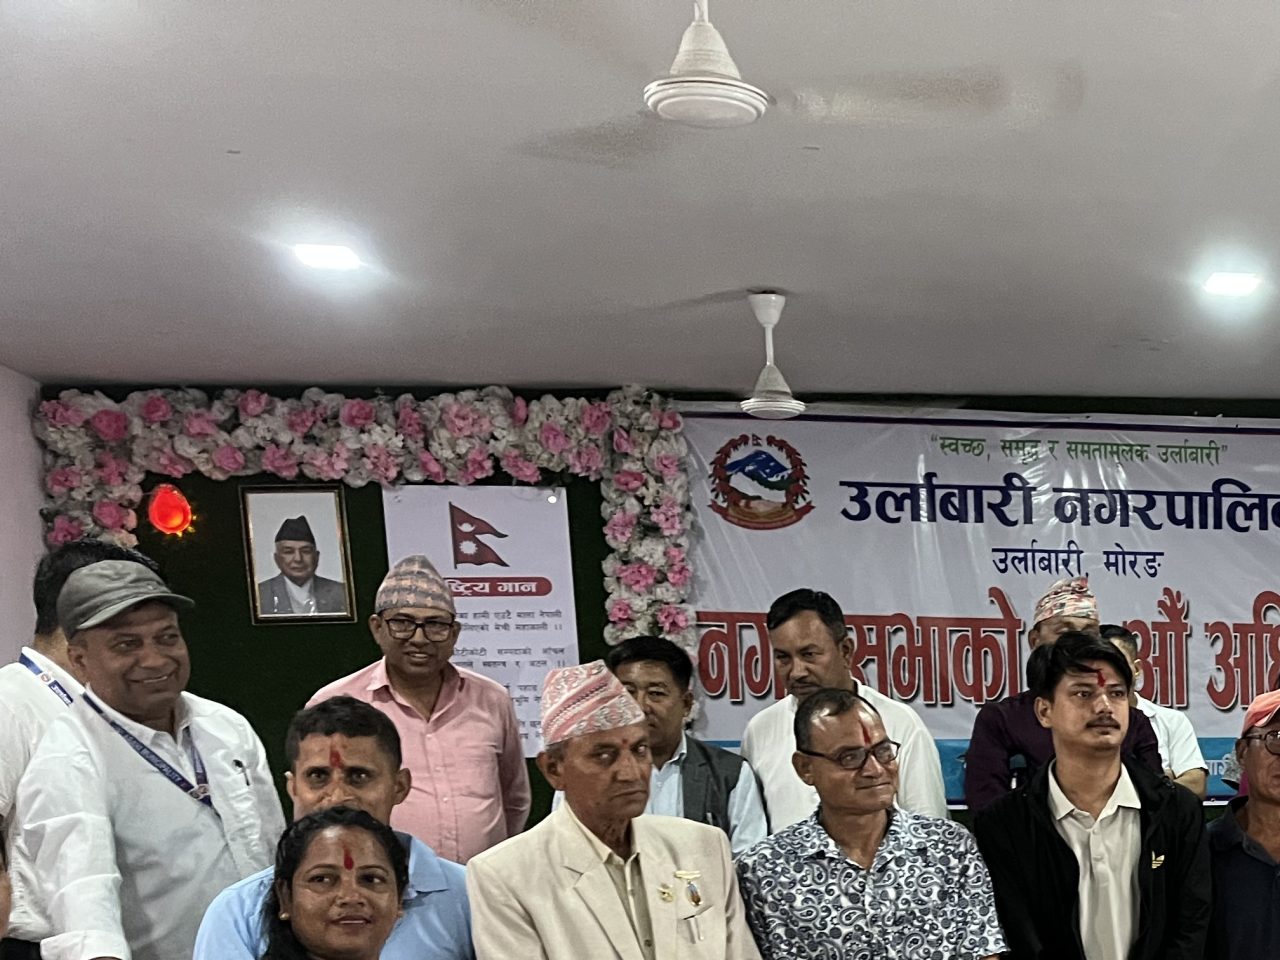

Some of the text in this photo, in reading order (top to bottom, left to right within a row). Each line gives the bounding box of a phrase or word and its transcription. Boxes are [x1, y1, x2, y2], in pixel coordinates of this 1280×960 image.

[1048, 440, 1060, 460] र
[839, 472, 1037, 528] उर्लाबारी
[1103, 542, 1164, 579] मोरङ
[496, 582, 538, 592] गान
[696, 611, 790, 702] नग
